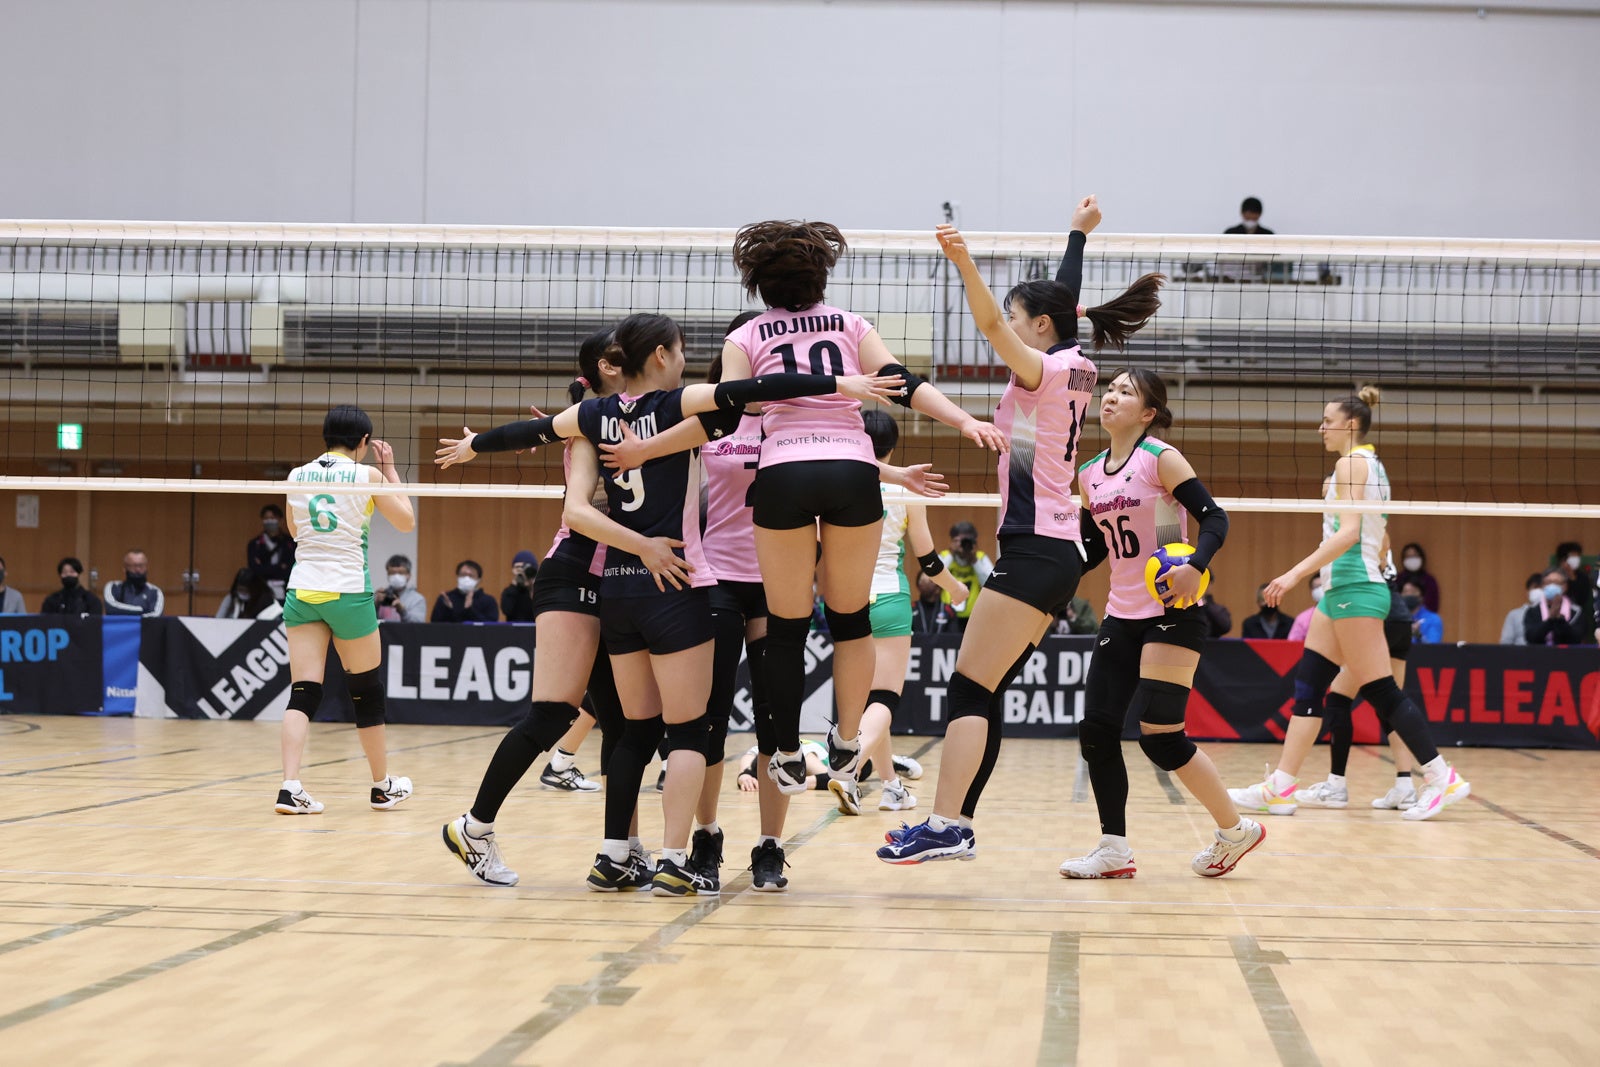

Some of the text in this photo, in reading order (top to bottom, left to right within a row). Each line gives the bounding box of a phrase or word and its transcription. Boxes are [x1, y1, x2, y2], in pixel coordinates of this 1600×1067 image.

[758, 313, 844, 341] NOJIMA
[776, 436, 810, 447] ROUTE
[832, 437, 861, 446] HOTELS
[308, 493, 338, 532] 6
[1099, 515, 1140, 560] 16
[604, 567, 620, 577] ROUTE
[578, 587, 598, 604] 19
[386, 644, 536, 702] LEAG
